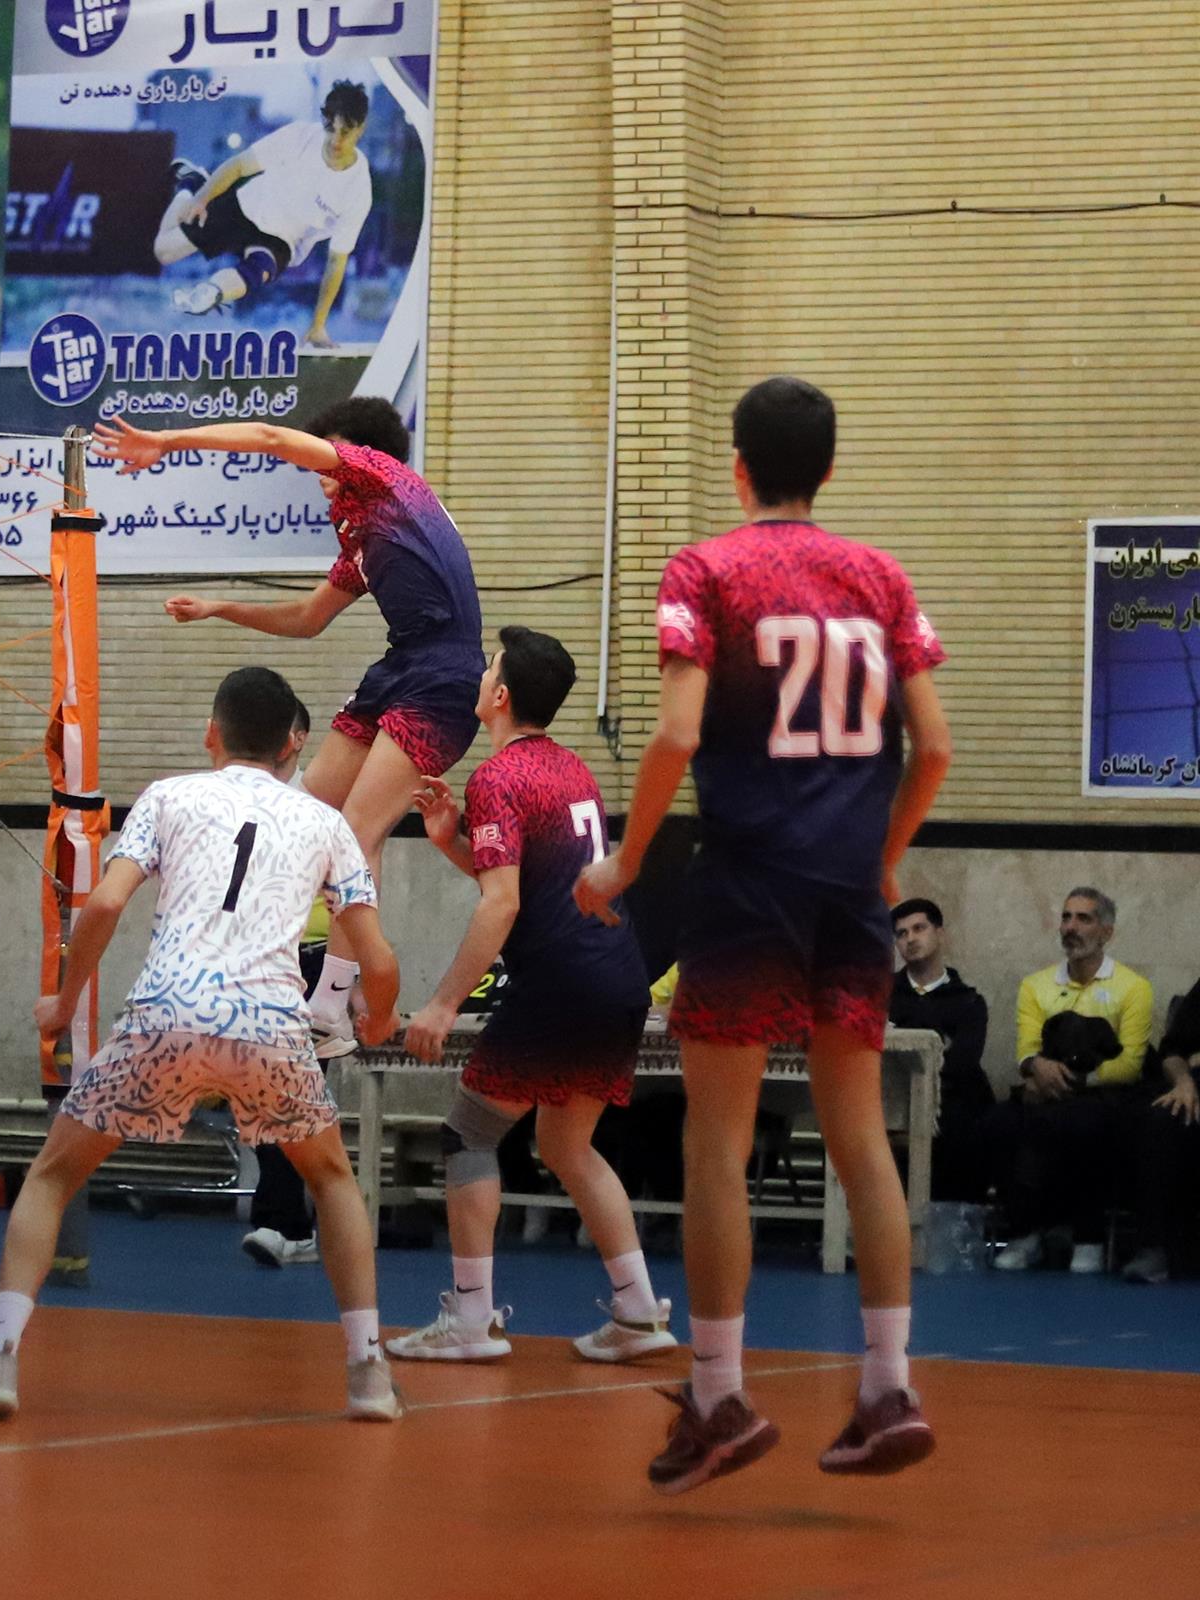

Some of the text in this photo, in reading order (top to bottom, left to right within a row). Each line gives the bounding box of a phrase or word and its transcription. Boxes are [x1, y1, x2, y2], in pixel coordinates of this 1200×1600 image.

[59, 77, 228, 104] تن یار یاری دهنده تن
[111, 330, 297, 381] TANYAR
[102, 387, 297, 416] تن یار یاری دهنده تن
[162, 501, 261, 540] پارکینگ
[1109, 539, 1162, 578] ایران
[755, 616, 887, 758] 20
[568, 799, 605, 865] 7
[221, 820, 258, 913] 1
[469, 973, 495, 998] 2
